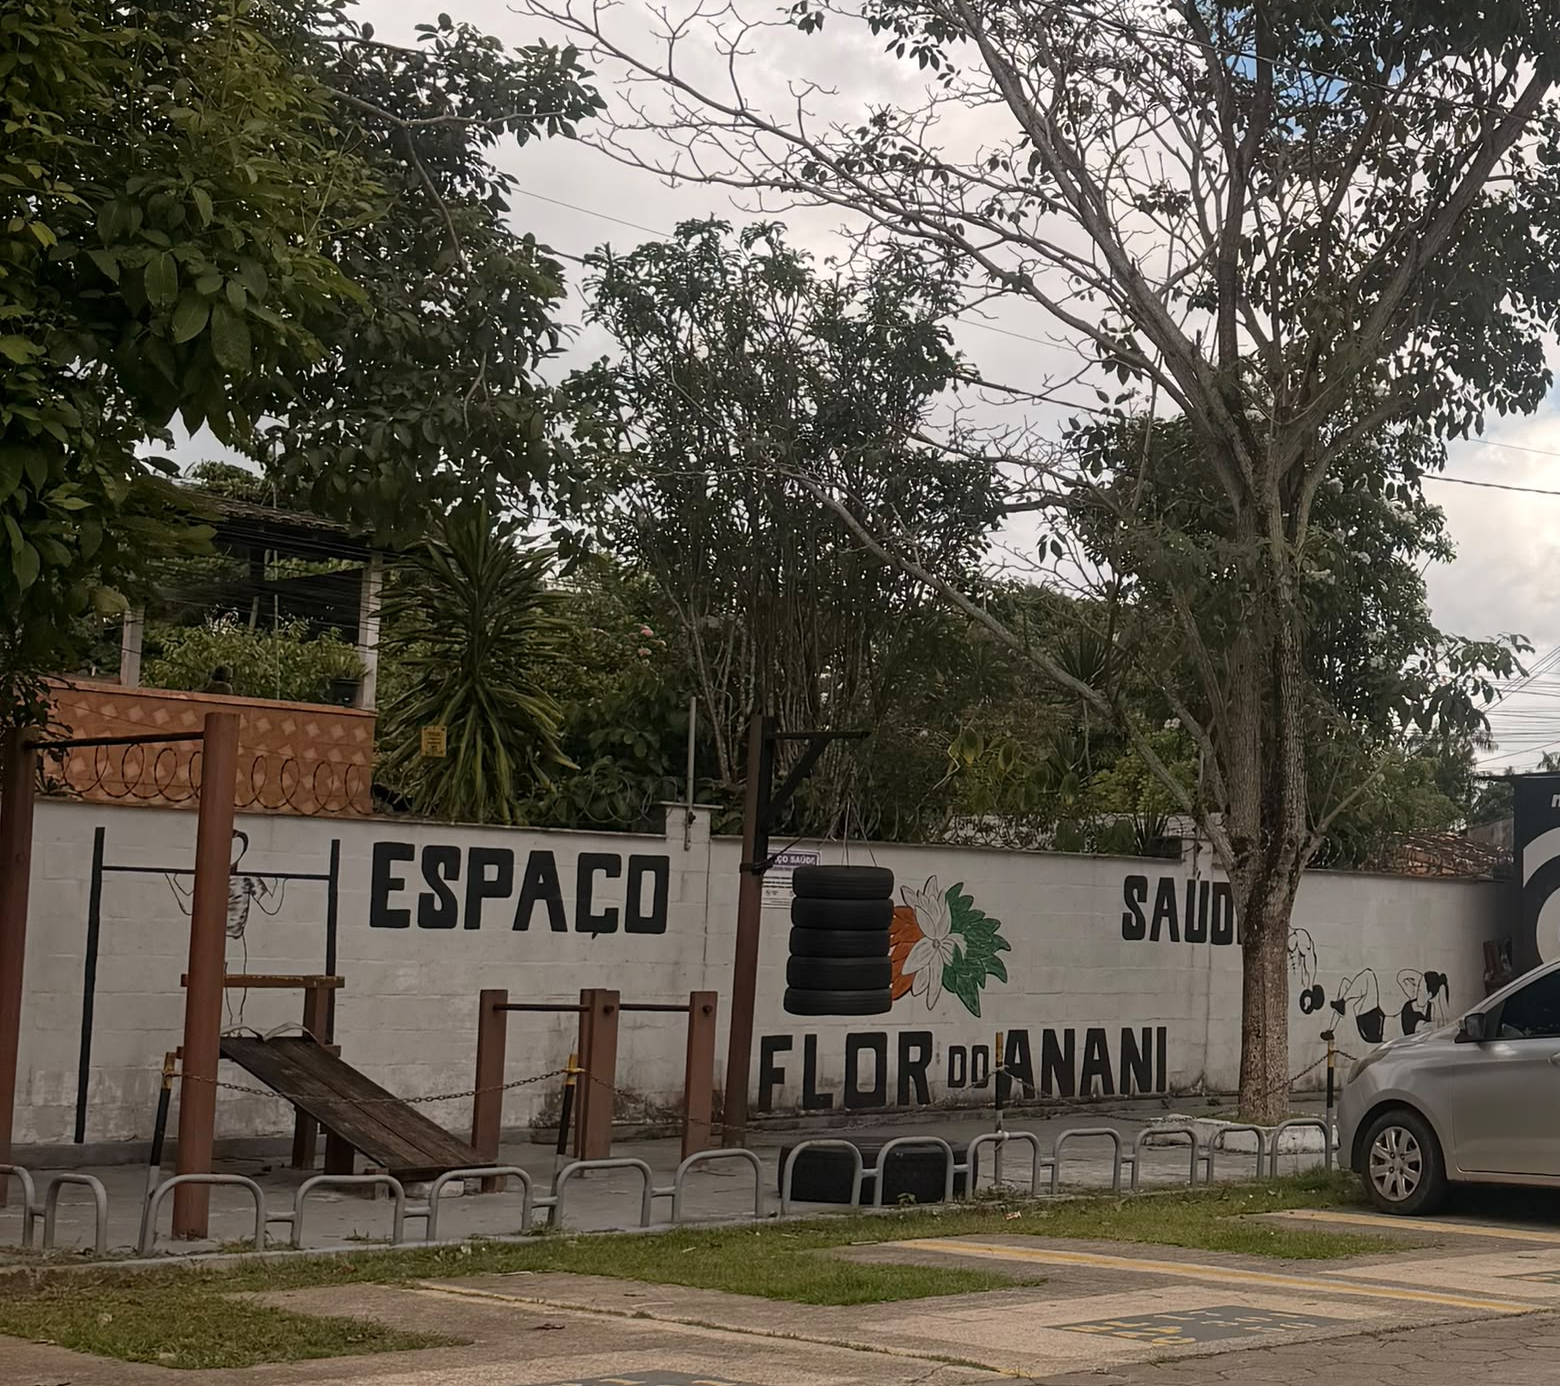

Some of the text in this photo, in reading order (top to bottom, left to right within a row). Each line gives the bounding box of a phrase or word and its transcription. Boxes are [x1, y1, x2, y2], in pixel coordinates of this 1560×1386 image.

[369, 841, 1244, 945] ESPAÇO SAÚD
[758, 1026, 1168, 1110] FLOR DO ANANI
